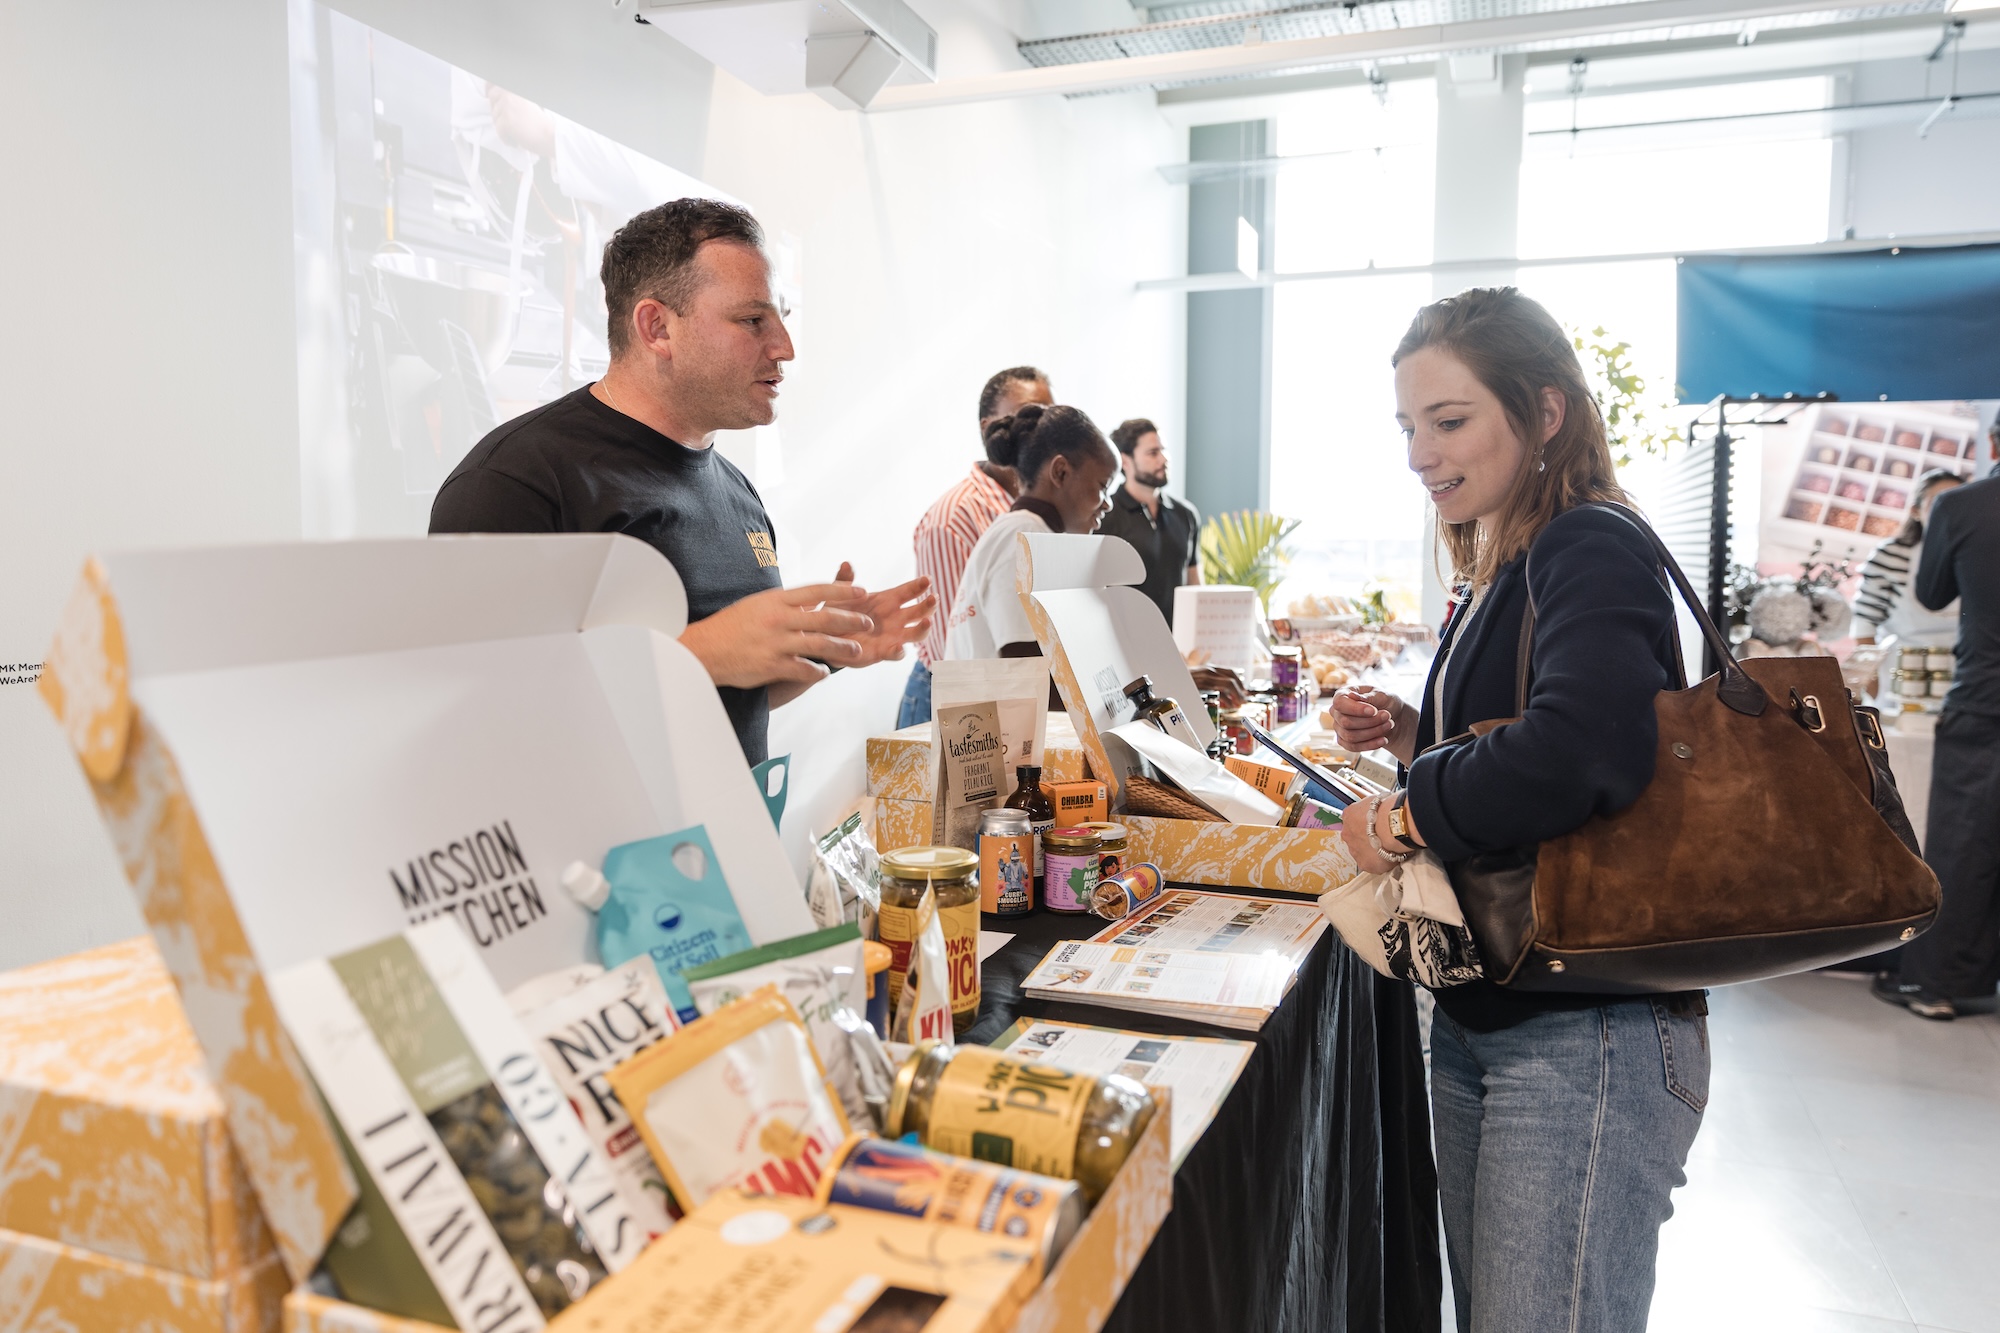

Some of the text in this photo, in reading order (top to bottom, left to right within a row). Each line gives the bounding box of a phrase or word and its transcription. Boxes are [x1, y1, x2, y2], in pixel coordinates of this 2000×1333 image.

[949, 731, 999, 758] tastesmiths
[964, 761, 991, 778] FRAGRANT
[963, 773, 994, 791] PILAU RICE
[1061, 794, 1094, 807] CHHABRA
[389, 820, 528, 911] MISSION
[1005, 890, 1023, 898] CURRY
[651, 928, 718, 963] Citizens
[547, 997, 660, 1075] NICE
